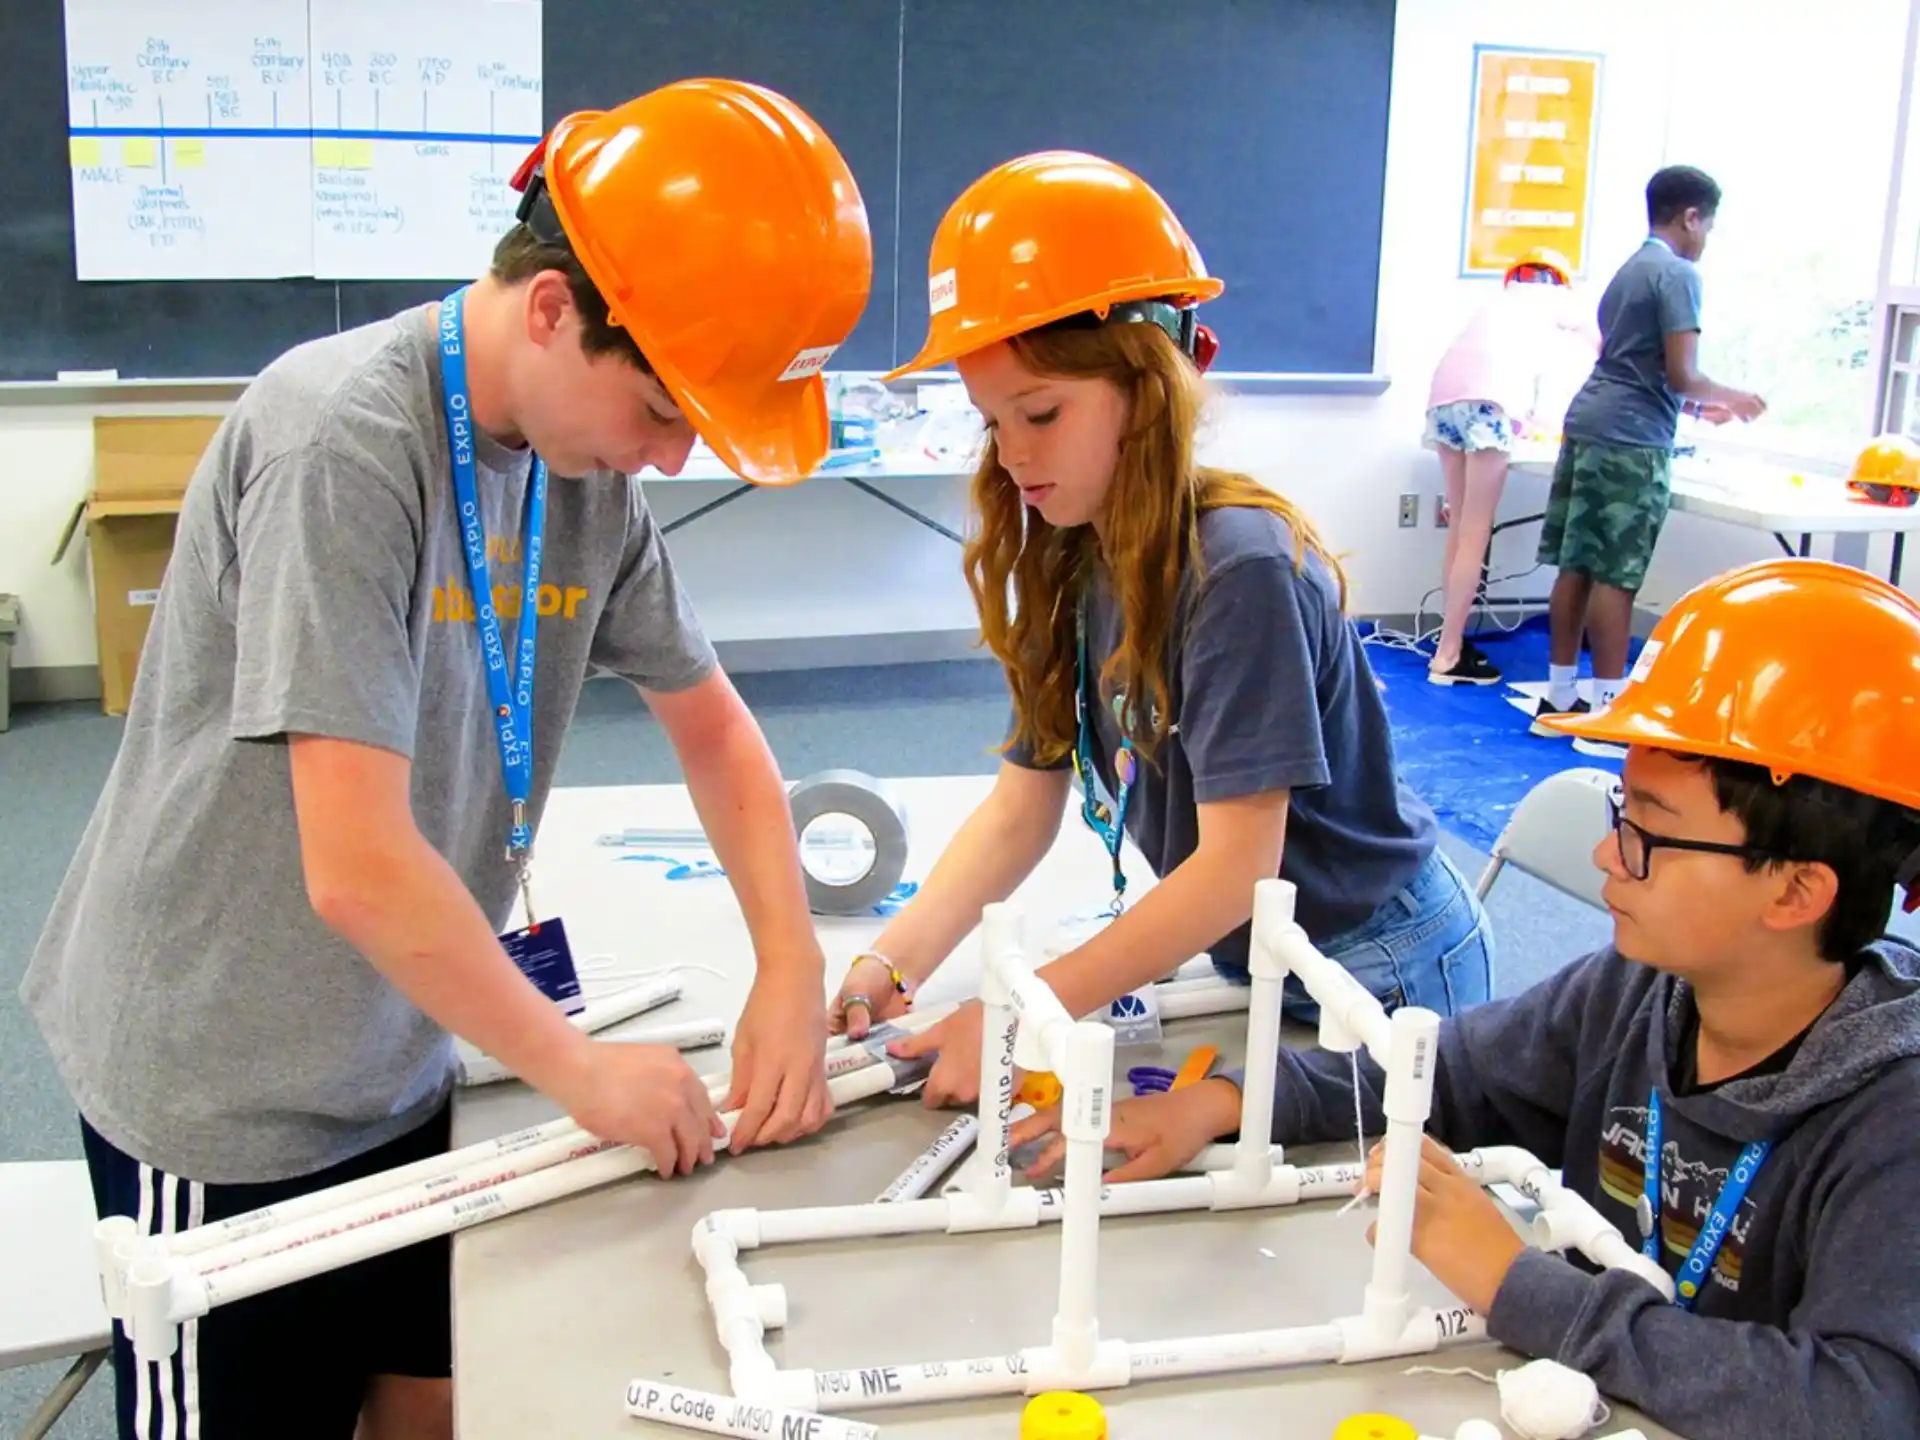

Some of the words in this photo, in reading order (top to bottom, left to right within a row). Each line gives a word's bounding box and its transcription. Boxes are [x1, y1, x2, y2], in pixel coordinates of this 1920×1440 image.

[441, 299, 461, 355] EXPLO
[451, 393, 471, 465] EXPLO
[463, 502, 484, 570] EXPLO
[527, 536, 541, 603] EXPLO
[480, 603, 503, 671] EXPLO
[517, 639, 534, 706] EXPLO
[497, 703, 520, 767] EXPLO
[1645, 1109, 1660, 1180] EXPLO
[1735, 1142, 1766, 1184] PLO
[1690, 1211, 1726, 1274] EXPLO
[1434, 1307, 1475, 1338] 1/2"
[626, 1385, 664, 1413] U.P.
[670, 1392, 716, 1422] Code
[726, 1403, 773, 1434] JM90
[860, 1366, 902, 1398] ME
